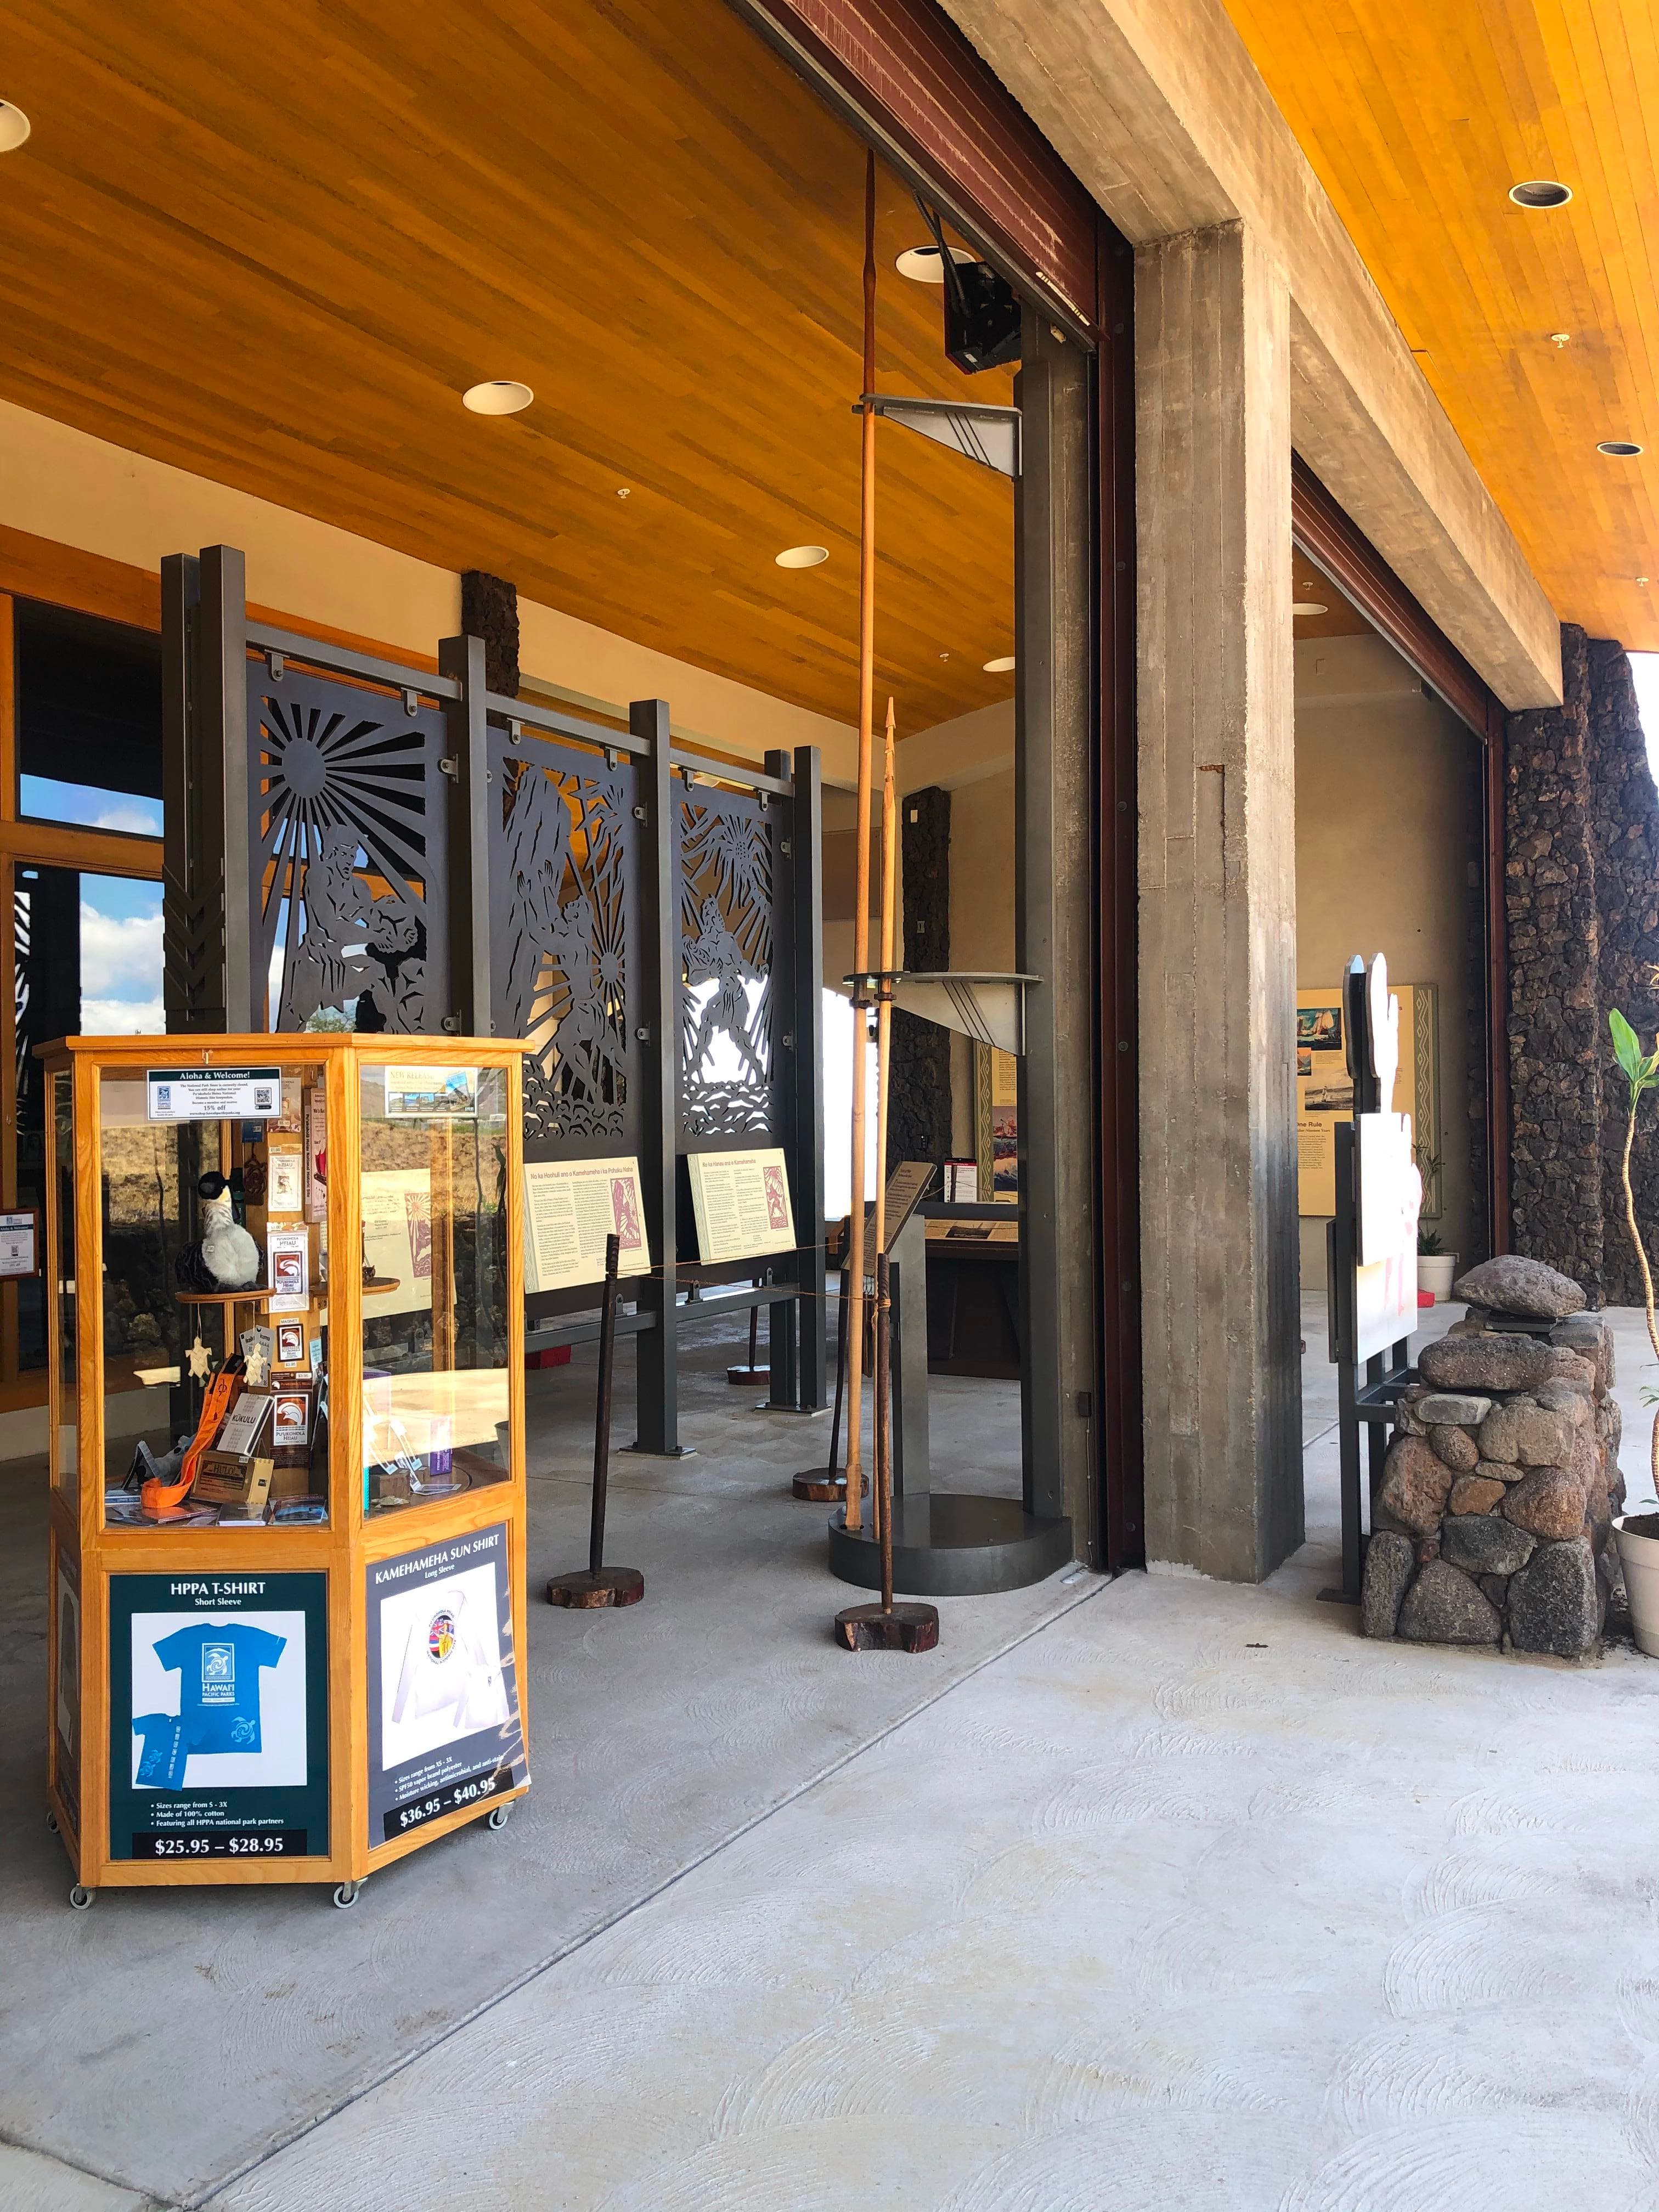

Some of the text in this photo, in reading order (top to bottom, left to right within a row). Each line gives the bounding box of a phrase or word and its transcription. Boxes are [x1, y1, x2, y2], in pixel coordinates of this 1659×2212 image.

[232, 1414, 256, 1424] KŪKULU
[375, 1534, 500, 1584] KAMEHAMEHA SUN SHIRT
[425, 1564, 455, 1579] Long Sleeve
[171, 1582, 266, 1595] HPPA T-SHIRT
[399, 1775, 410, 1784] Sizes
[411, 1769, 424, 1778] range
[424, 1764, 436, 1773] from
[399, 1762, 462, 1792] SPF50 vapor brand polyester
[399, 1788, 420, 1801] Moisture
[420, 1780, 439, 1791] wicking,
[440, 1766, 471, 1783] antimicrobial,
[472, 1762, 481, 1770] and
[400, 1798, 439, 1827] $36.95
[454, 1776, 496, 1804] $40.95
[242, 1818, 256, 1826] park
[155, 1839, 210, 1856] $25.95
[229, 1837, 284, 1854] $28.95
